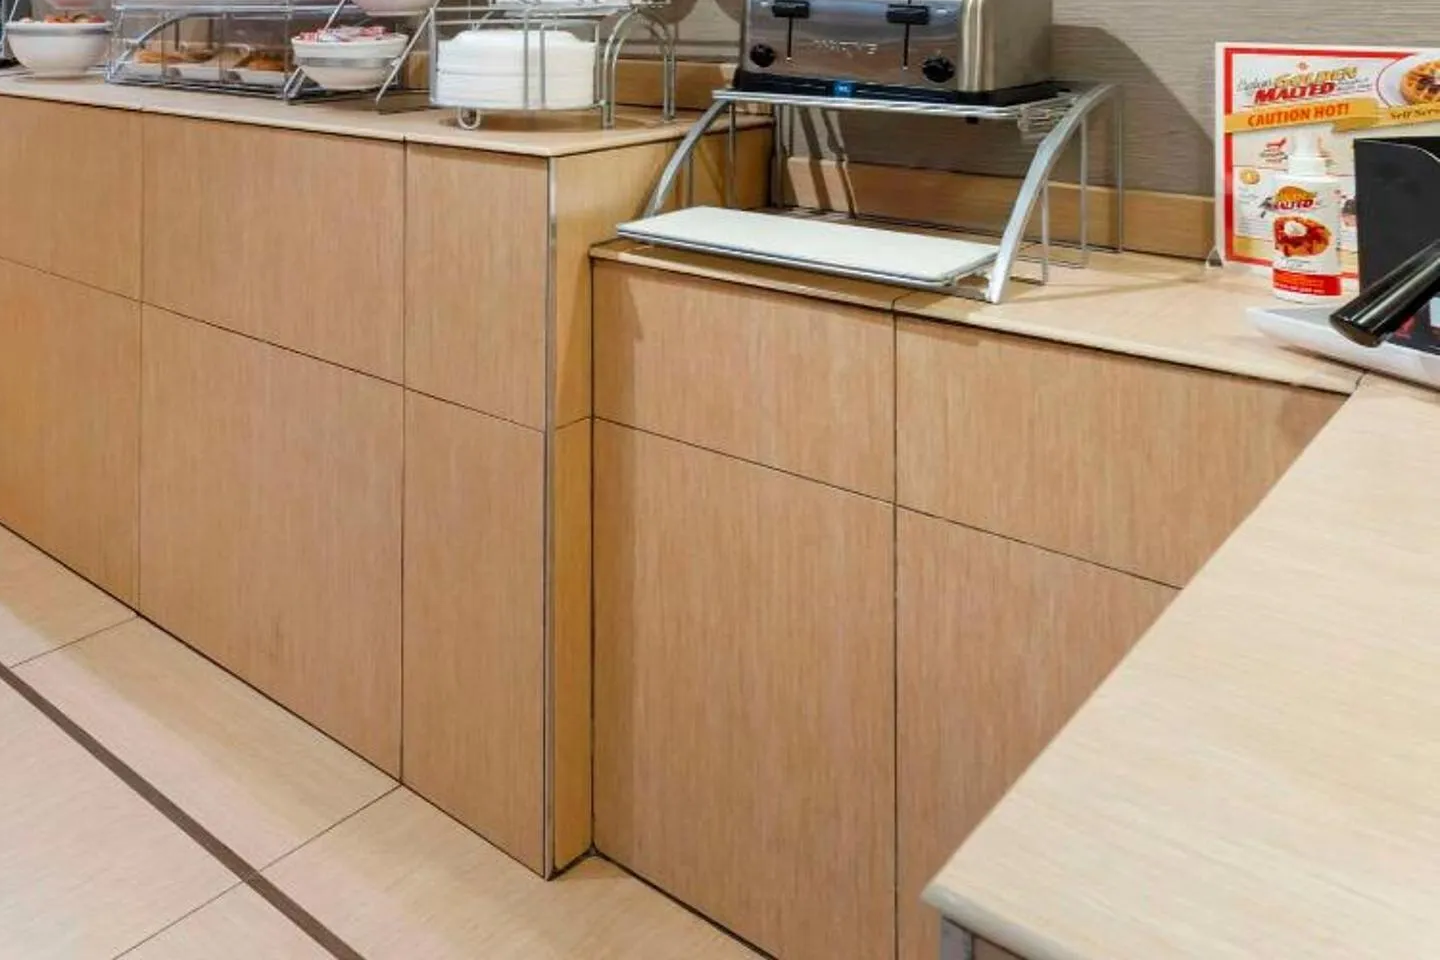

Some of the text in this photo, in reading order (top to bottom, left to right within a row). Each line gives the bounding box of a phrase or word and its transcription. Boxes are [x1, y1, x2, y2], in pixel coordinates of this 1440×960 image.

[1254, 81, 1337, 104] MALTED
[1248, 103, 1350, 127] CAUTION HOT!
